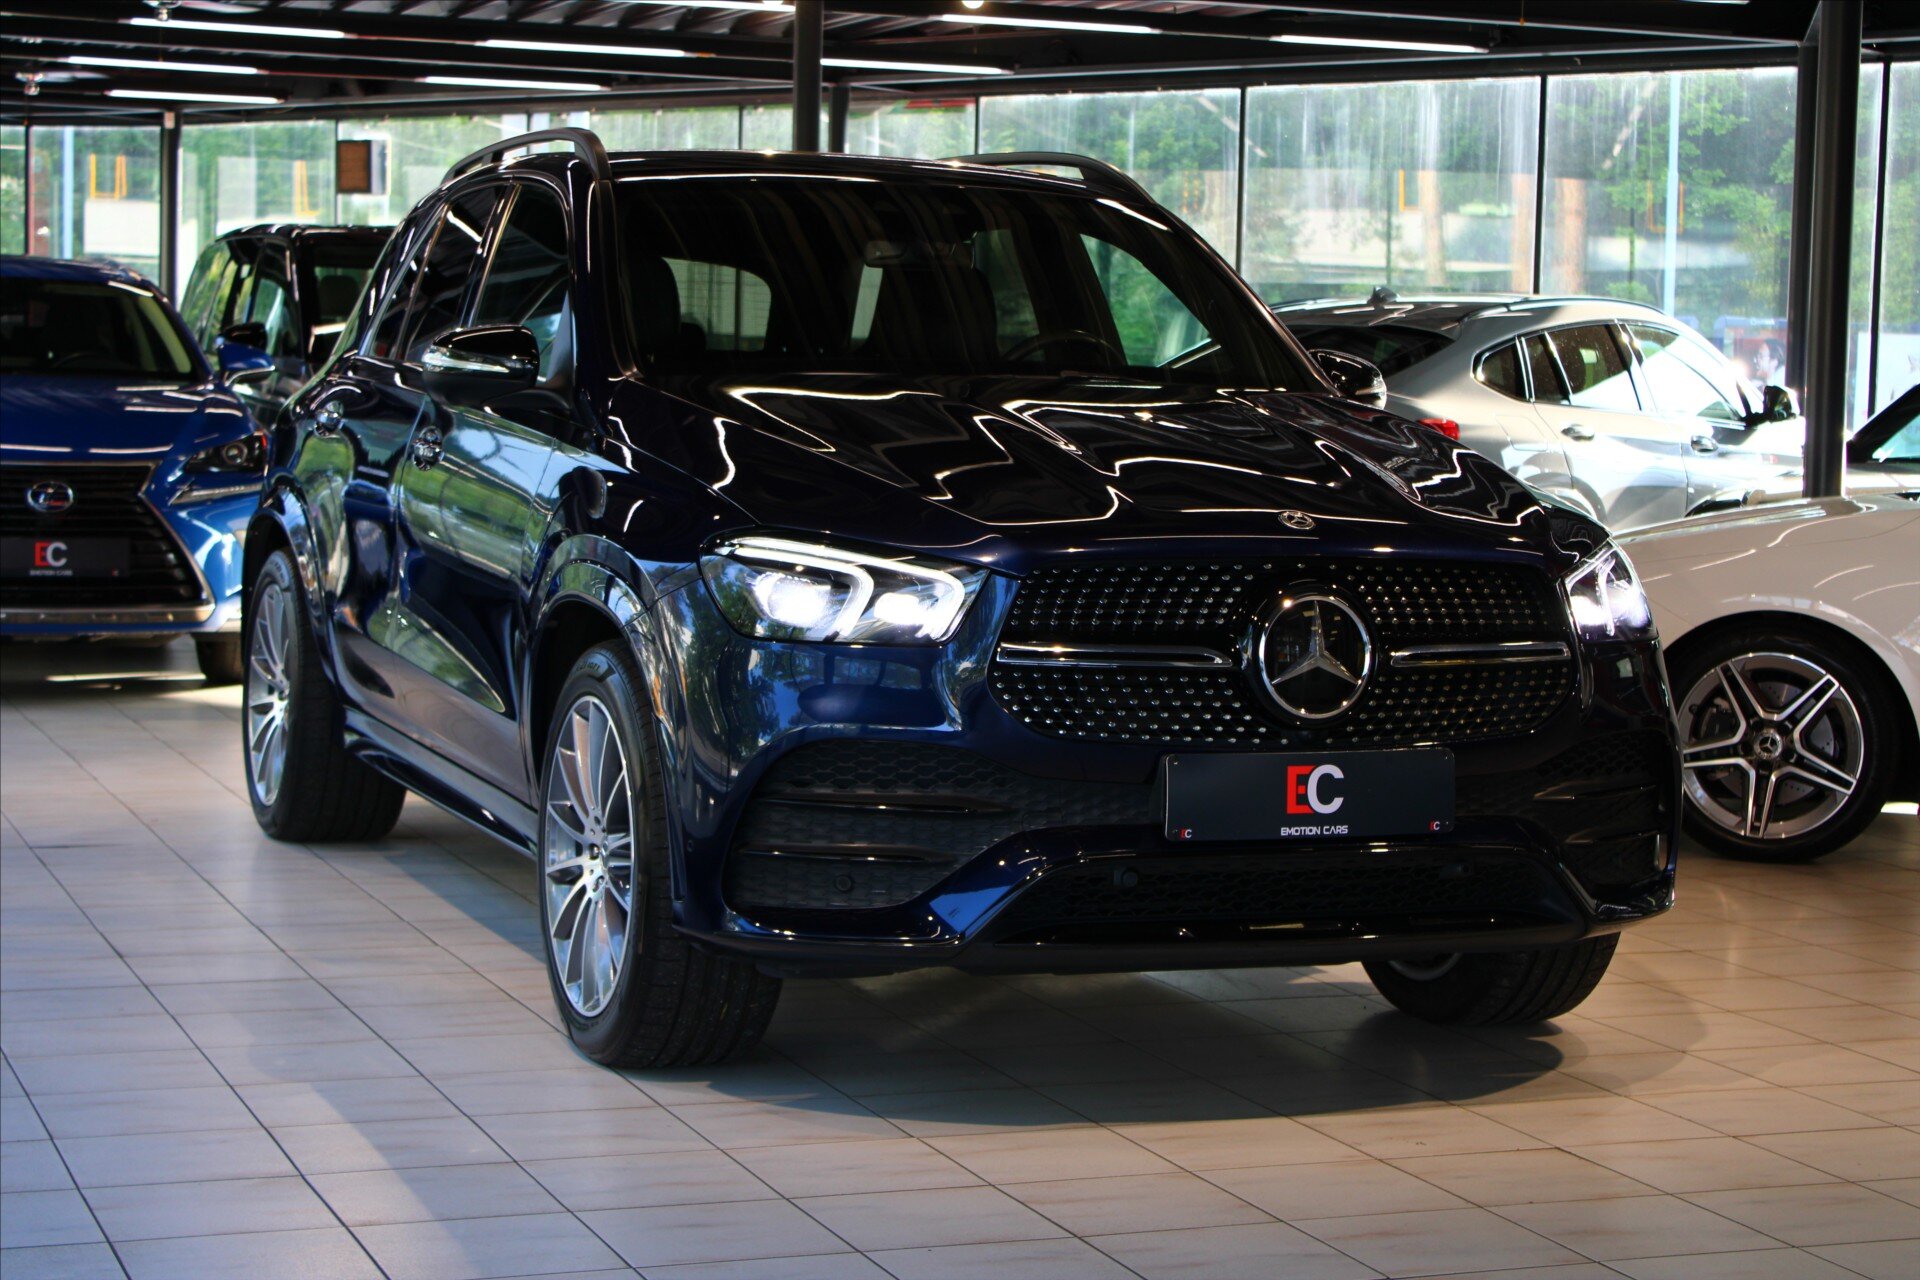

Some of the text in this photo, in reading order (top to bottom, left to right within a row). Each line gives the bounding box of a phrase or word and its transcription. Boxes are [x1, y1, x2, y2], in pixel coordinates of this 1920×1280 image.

[34, 541, 68, 567] EC
[1287, 764, 1345, 814] EC
[1280, 825, 1349, 836] EMOTION CARS
